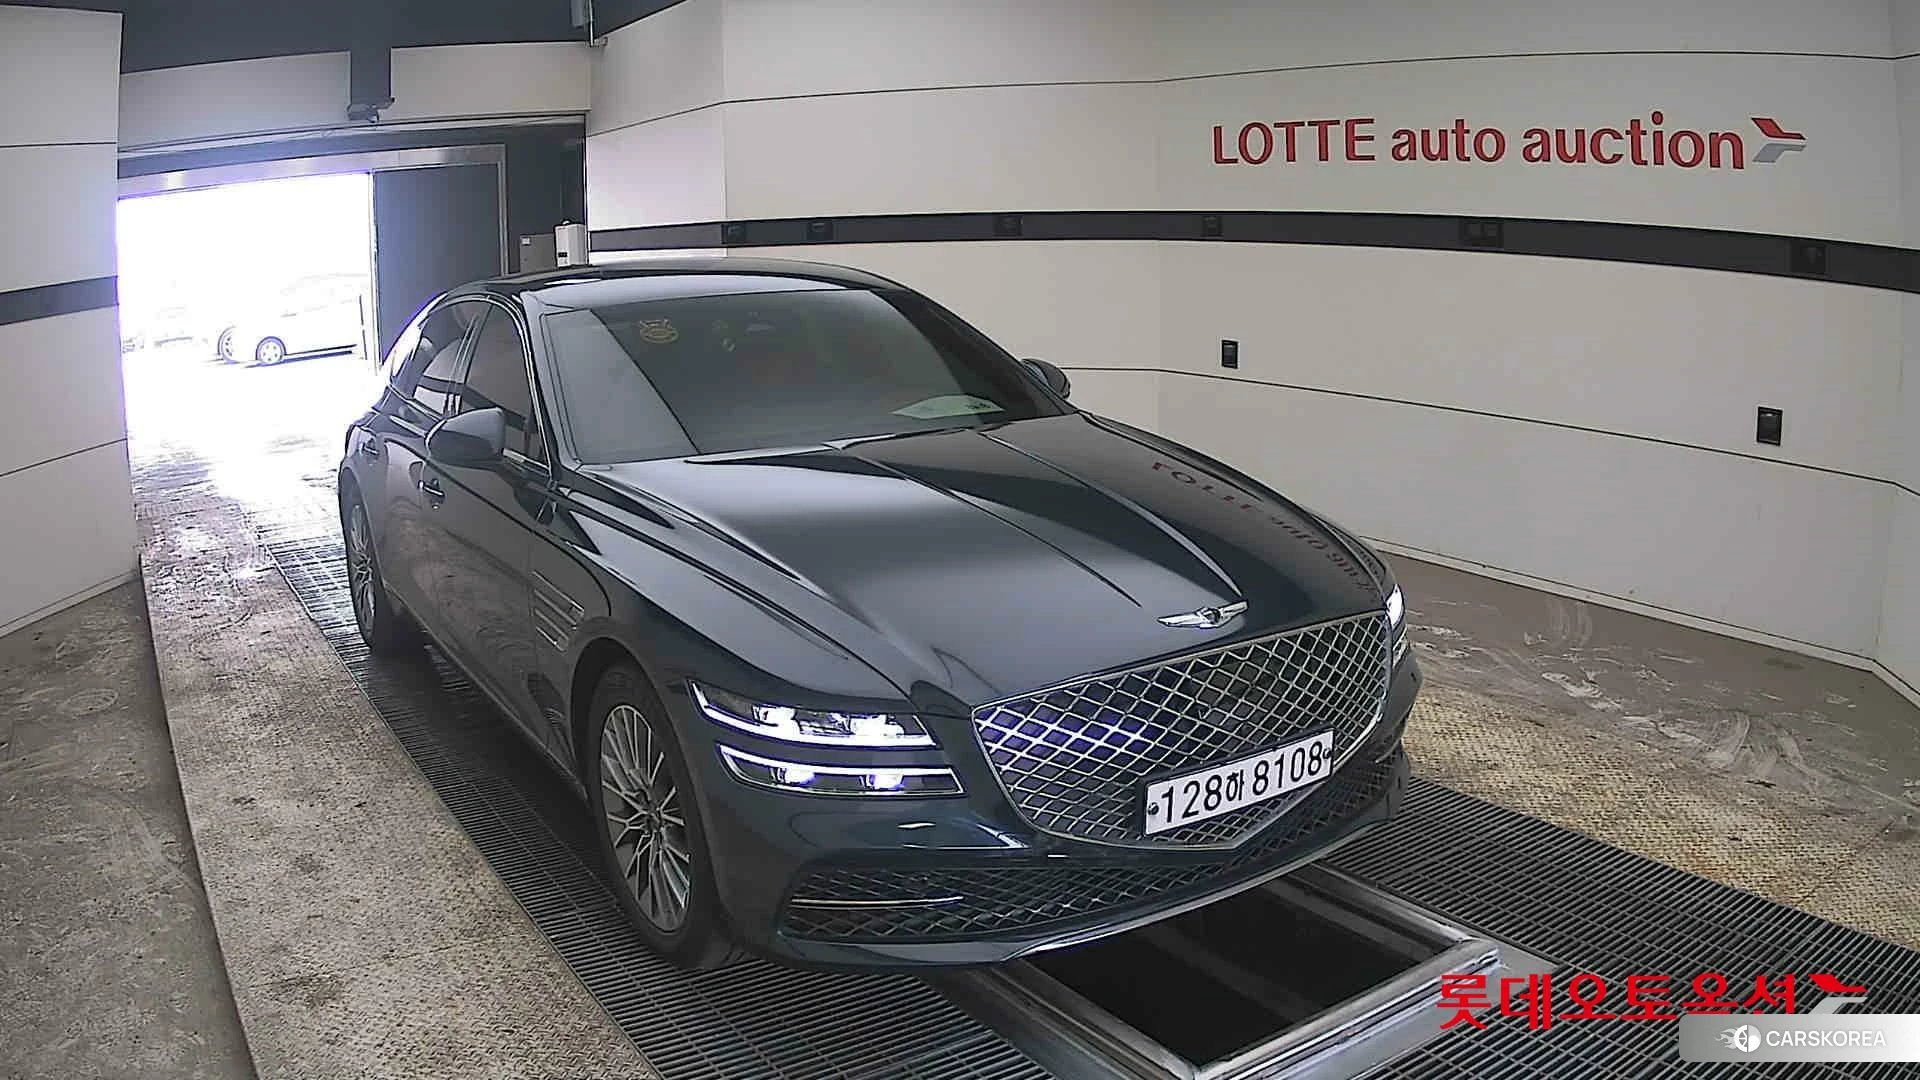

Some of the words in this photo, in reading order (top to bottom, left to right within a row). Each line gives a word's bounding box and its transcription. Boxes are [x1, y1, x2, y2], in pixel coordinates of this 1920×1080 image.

[1212, 117, 1376, 164] LOTTE
[1391, 118, 1506, 163] auto
[1522, 111, 1746, 170] auction
[1252, 741, 1322, 796] 8108
